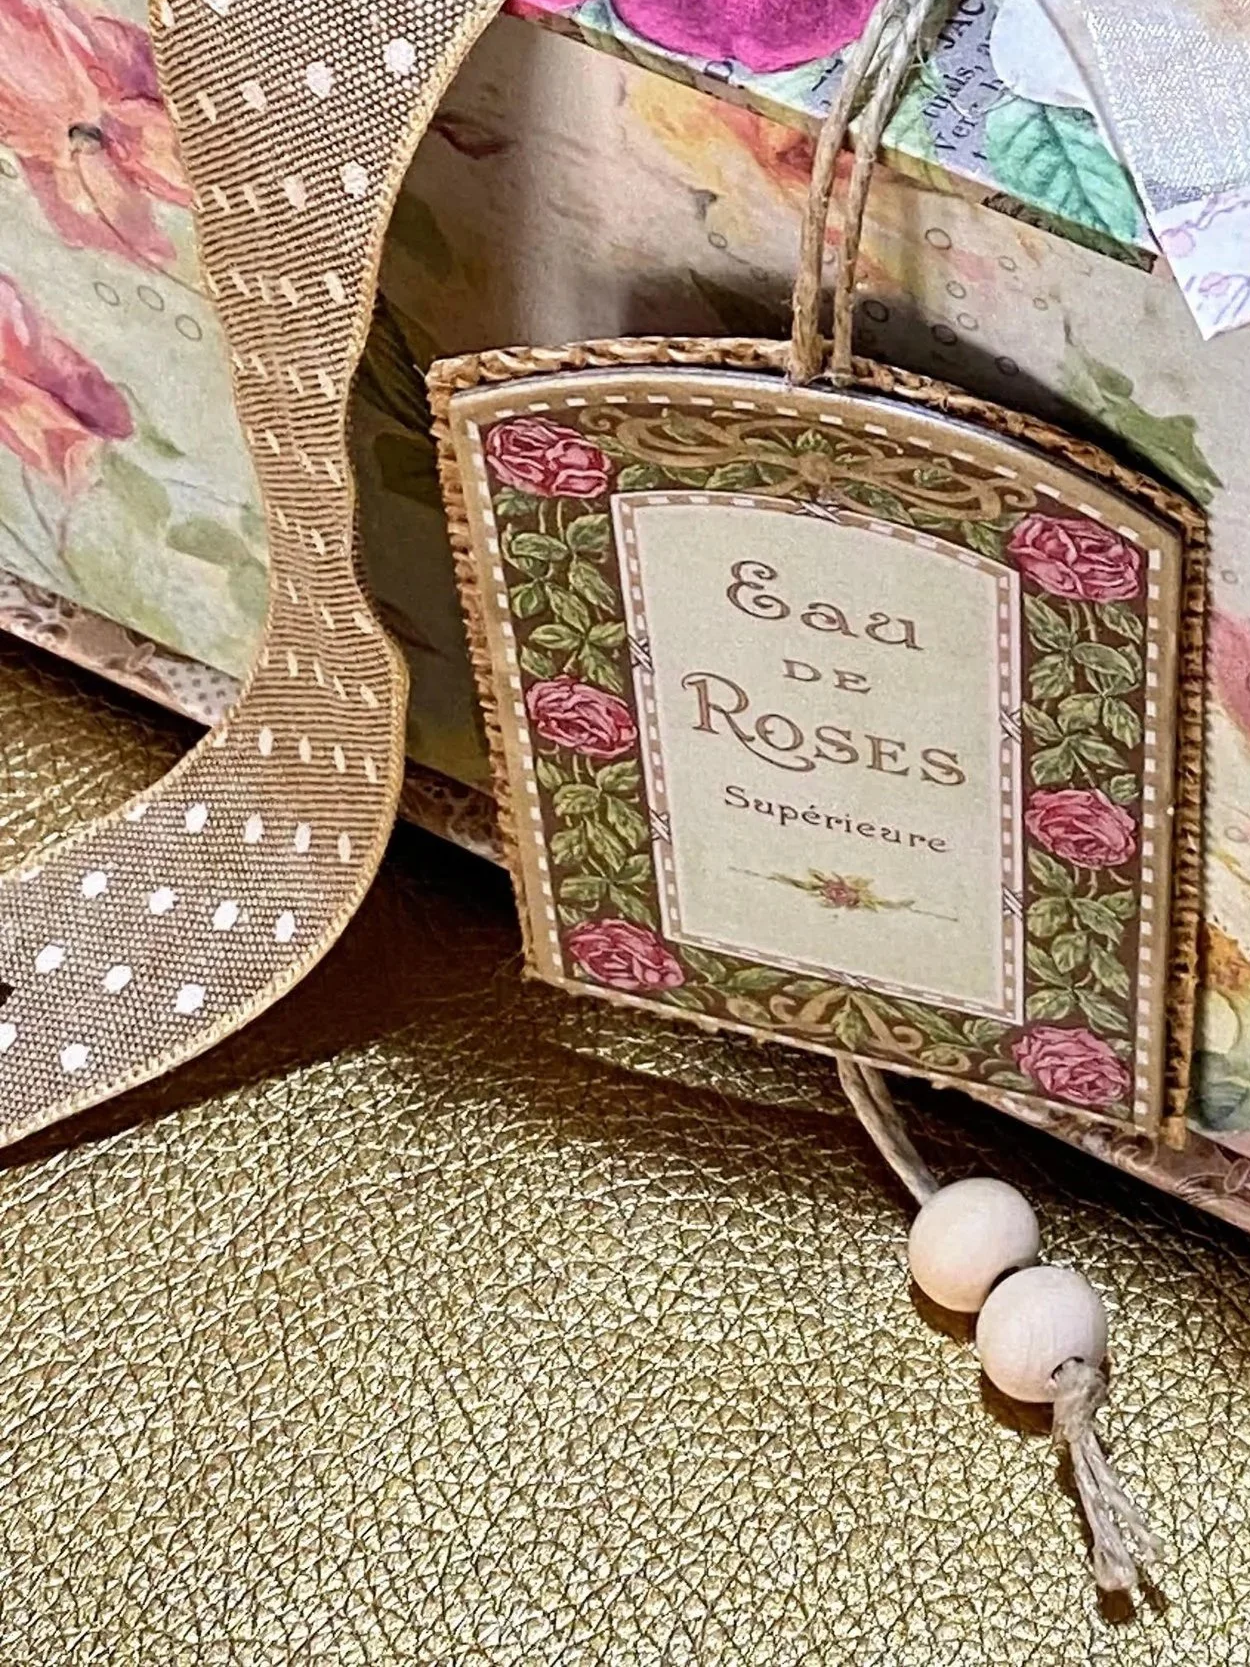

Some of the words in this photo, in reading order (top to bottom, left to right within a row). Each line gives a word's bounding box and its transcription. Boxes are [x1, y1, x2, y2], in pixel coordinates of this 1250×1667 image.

[725, 560, 925, 652] Eau
[783, 657, 872, 694] DE
[724, 785, 948, 854] Supérieure
